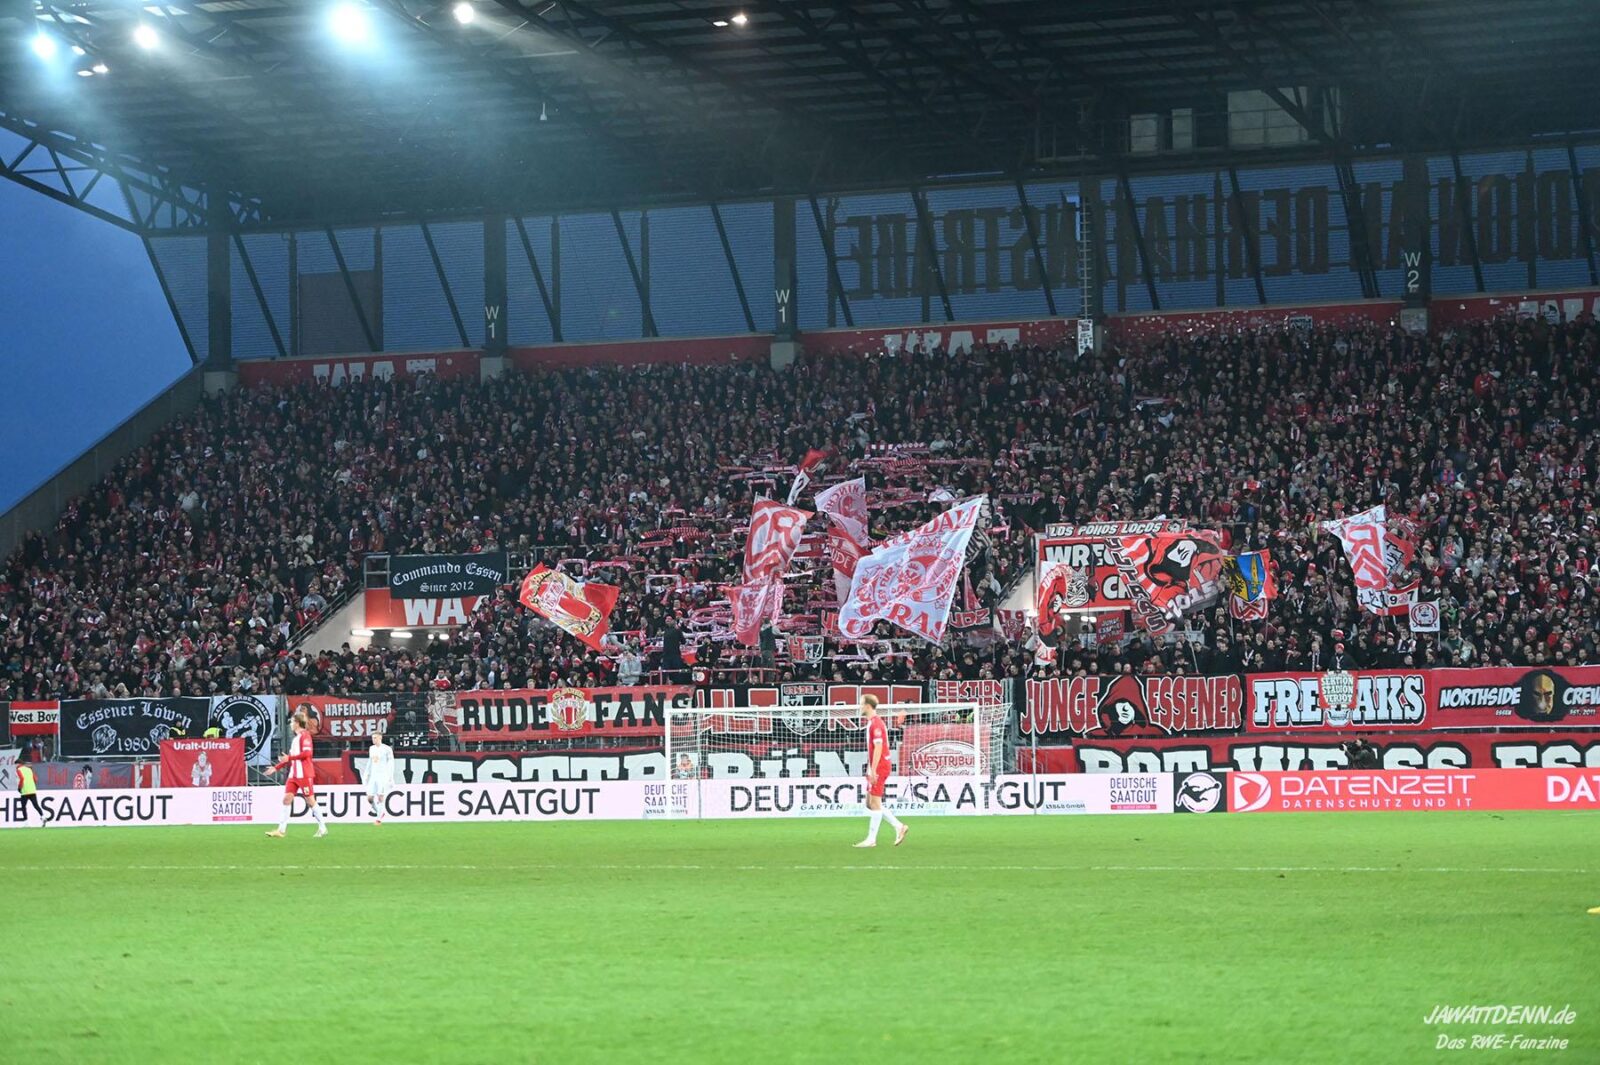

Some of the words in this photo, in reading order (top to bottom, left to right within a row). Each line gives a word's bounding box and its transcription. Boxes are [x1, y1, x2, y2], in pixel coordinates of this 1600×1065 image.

[1404, 251, 1421, 267] W
[1407, 269, 1420, 288] 2
[775, 289, 790, 304] W
[485, 305, 500, 320] W
[778, 306, 786, 323] 1
[488, 322, 496, 339] 1
[1050, 526, 1074, 537] LOS
[1122, 521, 1162, 535] LOCOS
[1044, 542, 1114, 568] WREC
[392, 562, 461, 586] Commando
[465, 562, 502, 582] Essen
[419, 582, 448, 593] Since
[449, 580, 475, 592] 2012
[936, 680, 1003, 698] SEKTION
[1439, 686, 1522, 709] NORTHSIDE
[460, 695, 550, 731] RUDE
[1020, 676, 1101, 735] JUNGE
[1146, 674, 1244, 732] ESSENER
[9, 711, 33, 722] West
[76, 701, 135, 730] Essener
[330, 718, 388, 737] ESSEN
[117, 737, 150, 752] 1980
[173, 741, 231, 750] Uralt-Ultras
[1080, 745, 1467, 774] ROT-WESS
[644, 784, 689, 797] DEUTCHE
[1110, 777, 1158, 789] DEUTSCHE
[1280, 775, 1476, 796] DATENZEIT
[212, 791, 253, 802] DEUTSCHE
[457, 788, 601, 816] SAATGUT
[1110, 789, 1157, 804] SAATGUT
[1283, 799, 1402, 809] DATENSCHUTZ
[1413, 798, 1446, 808] UND
[1457, 797, 1472, 807] IT
[42, 795, 174, 822] SAATGUT
[212, 803, 253, 815] SAATGUT
